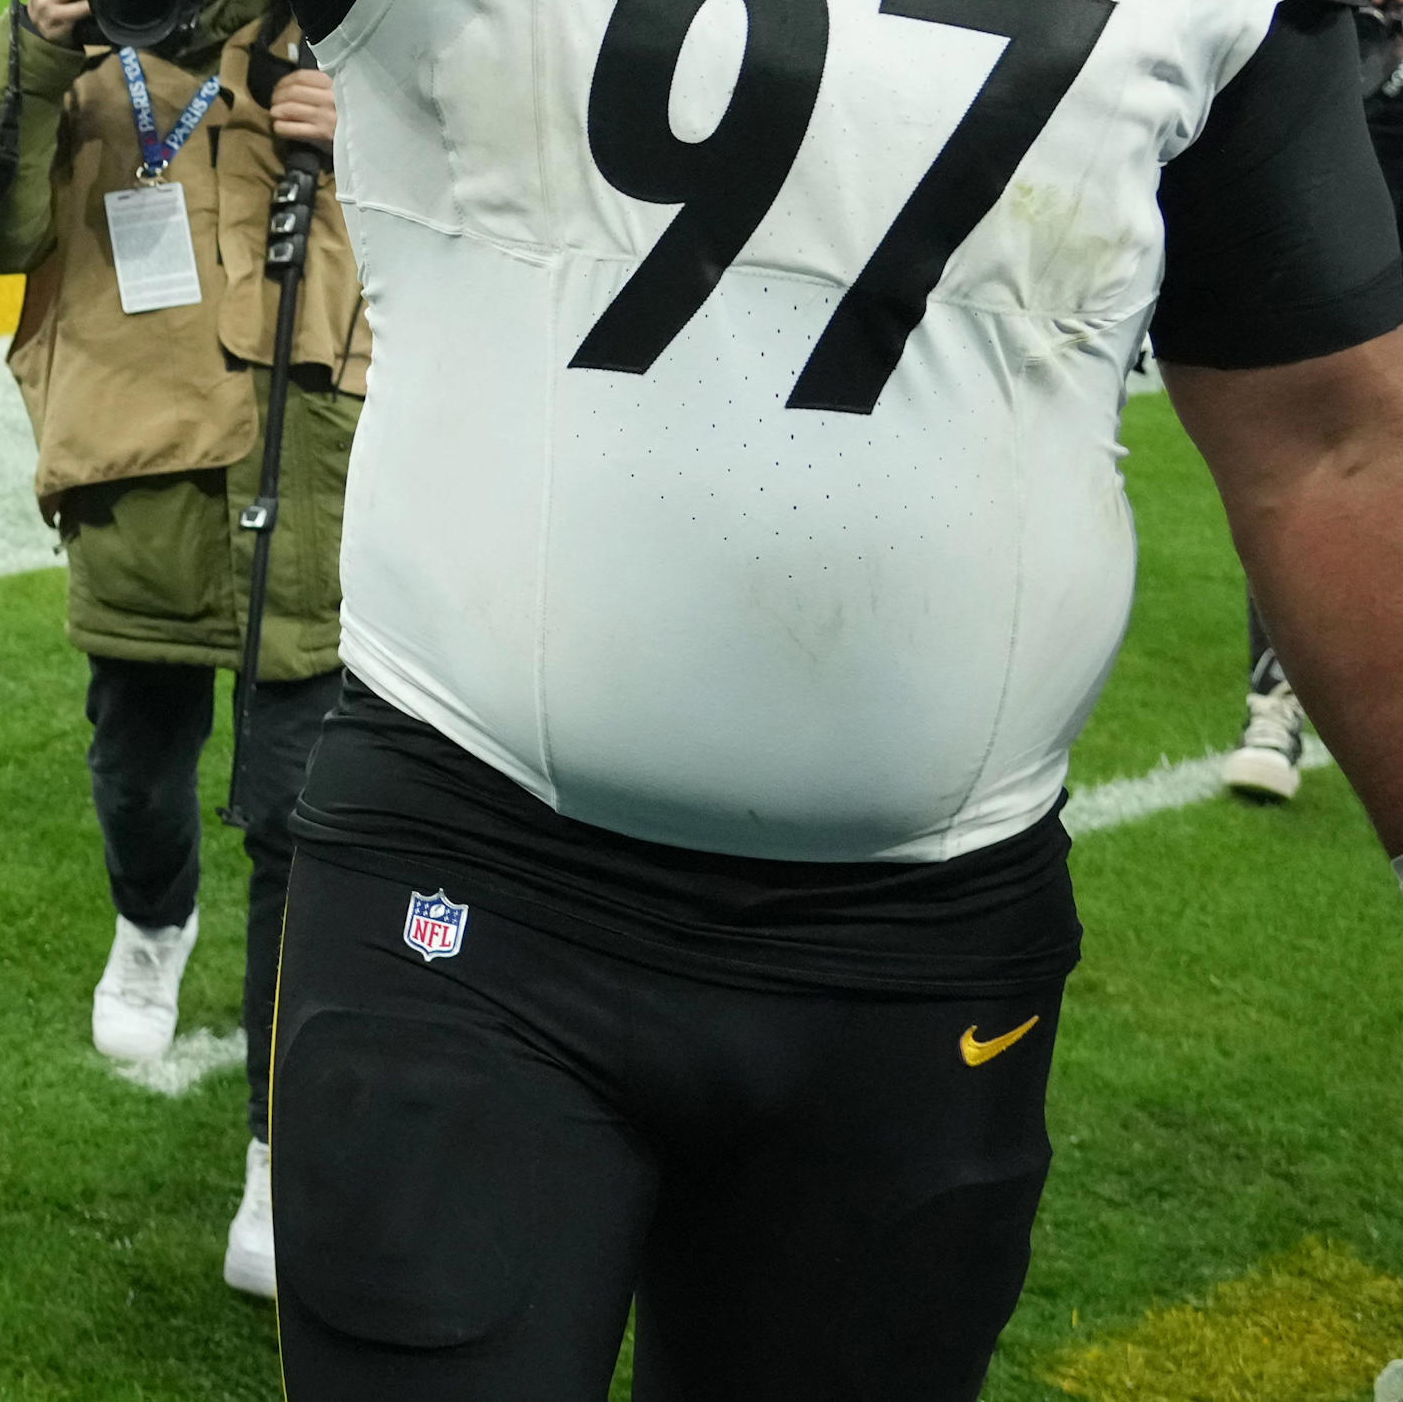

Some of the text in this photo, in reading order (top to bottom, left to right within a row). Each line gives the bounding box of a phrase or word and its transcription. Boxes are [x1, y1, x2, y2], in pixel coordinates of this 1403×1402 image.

[131, 80, 155, 133] PARIS
[165, 97, 209, 150] PARIS
[411, 918, 452, 948] NFL
